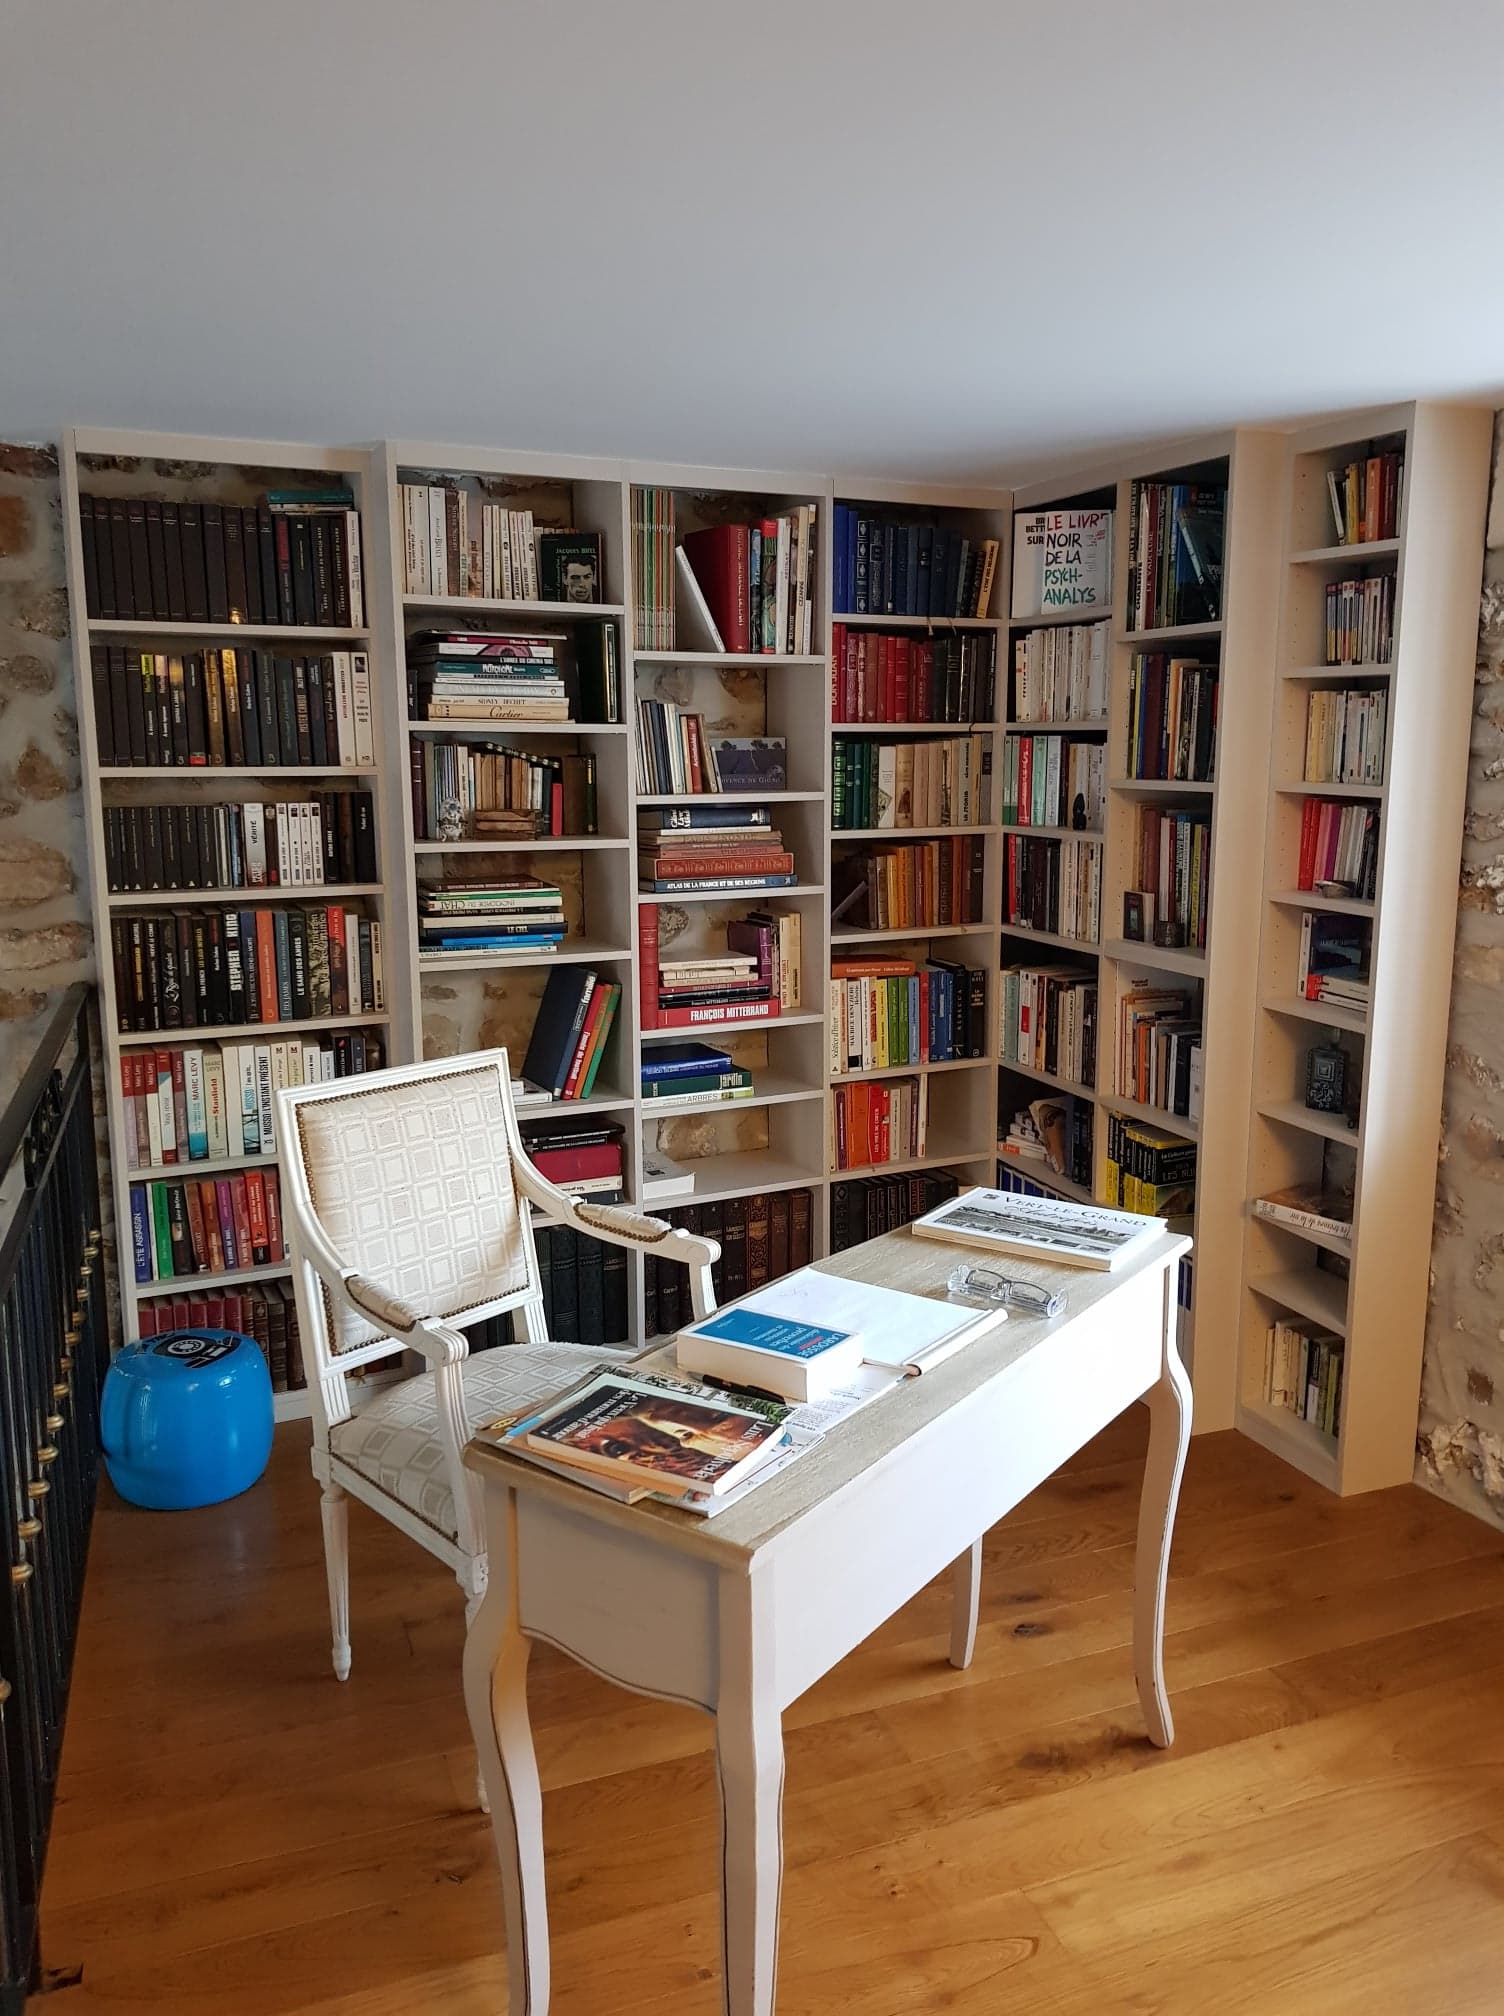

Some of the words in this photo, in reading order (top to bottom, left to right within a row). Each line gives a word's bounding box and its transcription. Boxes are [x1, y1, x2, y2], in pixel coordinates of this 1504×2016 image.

[1047, 514, 1063, 531] LE
[1027, 536, 1044, 544] SUR
[1046, 533, 1082, 549] NOIR
[1045, 551, 1062, 566] DE
[1066, 550, 1081, 565] LA
[1146, 530, 1154, 576] VAUCLUSE
[1045, 568, 1083, 586] PSYCH-
[1043, 587, 1096, 605] ANALYS
[489, 705, 523, 718] Cartier
[250, 820, 258, 844] VÉRITÉ
[226, 914, 238, 937] KING
[294, 937, 302, 957] ANGES
[228, 950, 242, 991] STEPHEN
[297, 987, 304, 996] LE
[691, 1008, 724, 1021] FRANÇOIS
[727, 1004, 768, 1017] MITTERRAND
[831, 1037, 839, 1058] Solstice
[258, 1056, 269, 1082] PRÉSENT
[191, 1079, 200, 1101] MARC
[210, 1078, 219, 1115] Stanfield
[260, 1083, 271, 1112] L'INSTANT
[687, 1093, 718, 1104] ARBRES
[262, 1113, 272, 1135] MUSSO
[1006, 1196, 1148, 1226] VERT-LE-GRAND
[133, 1212, 144, 1247] ASSASSIN
[768, 1326, 806, 1347] proverbes
[797, 1333, 843, 1357] LAROUSSE
[551, 1417, 588, 1440] d'amour
[743, 1419, 773, 1441] Luis
